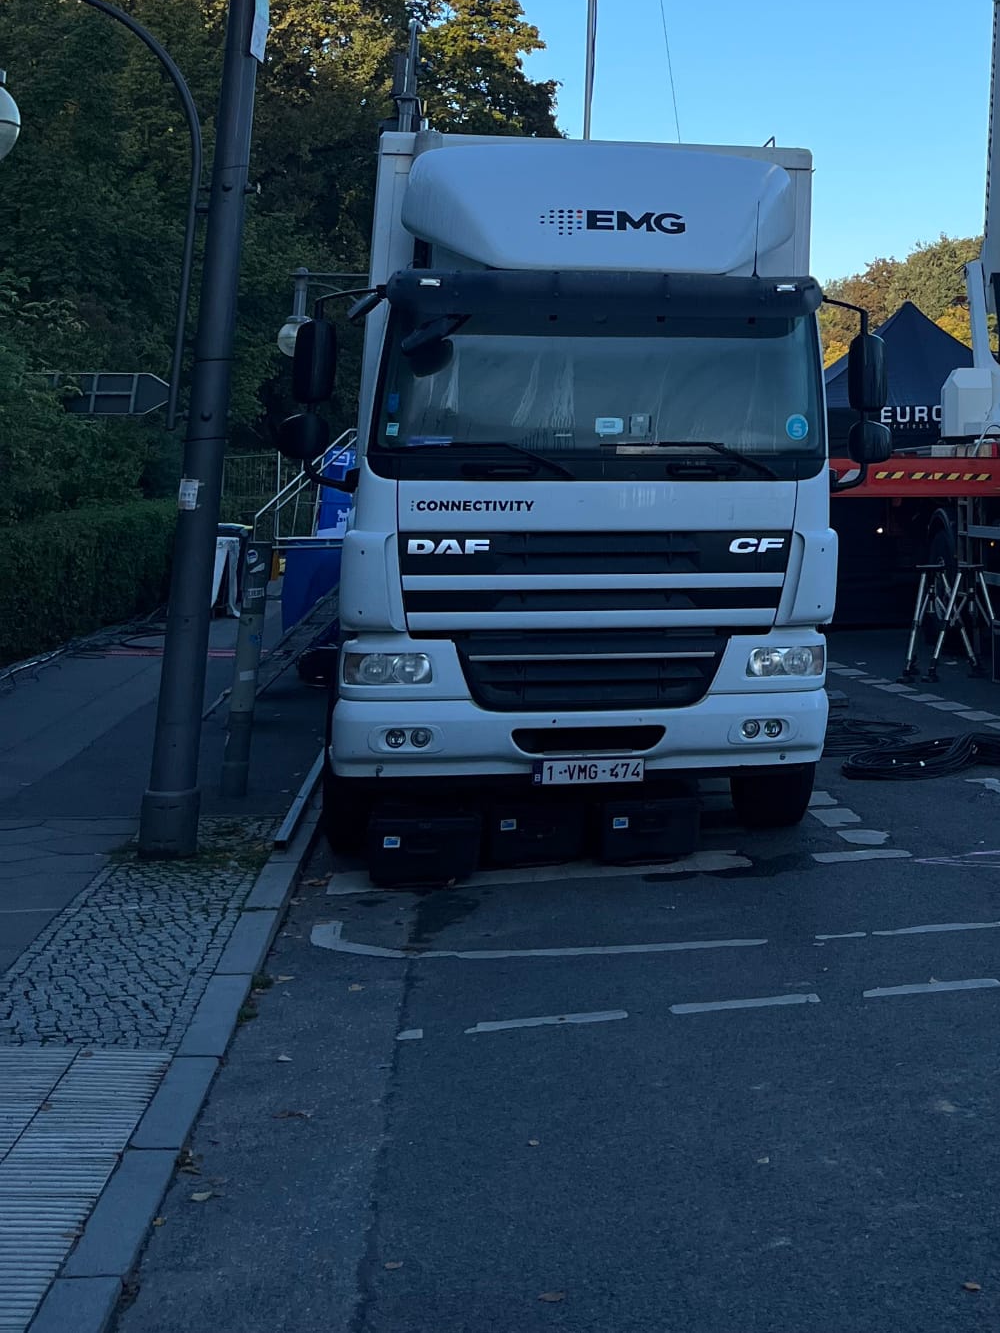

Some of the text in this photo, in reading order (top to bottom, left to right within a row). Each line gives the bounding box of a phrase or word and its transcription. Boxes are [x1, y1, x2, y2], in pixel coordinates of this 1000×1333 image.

[586, 209, 686, 235] EMG
[792, 423, 802, 435] 5
[416, 500, 535, 513] CONNECTIVITY
[407, 539, 490, 555] DAF
[728, 537, 785, 554] CF
